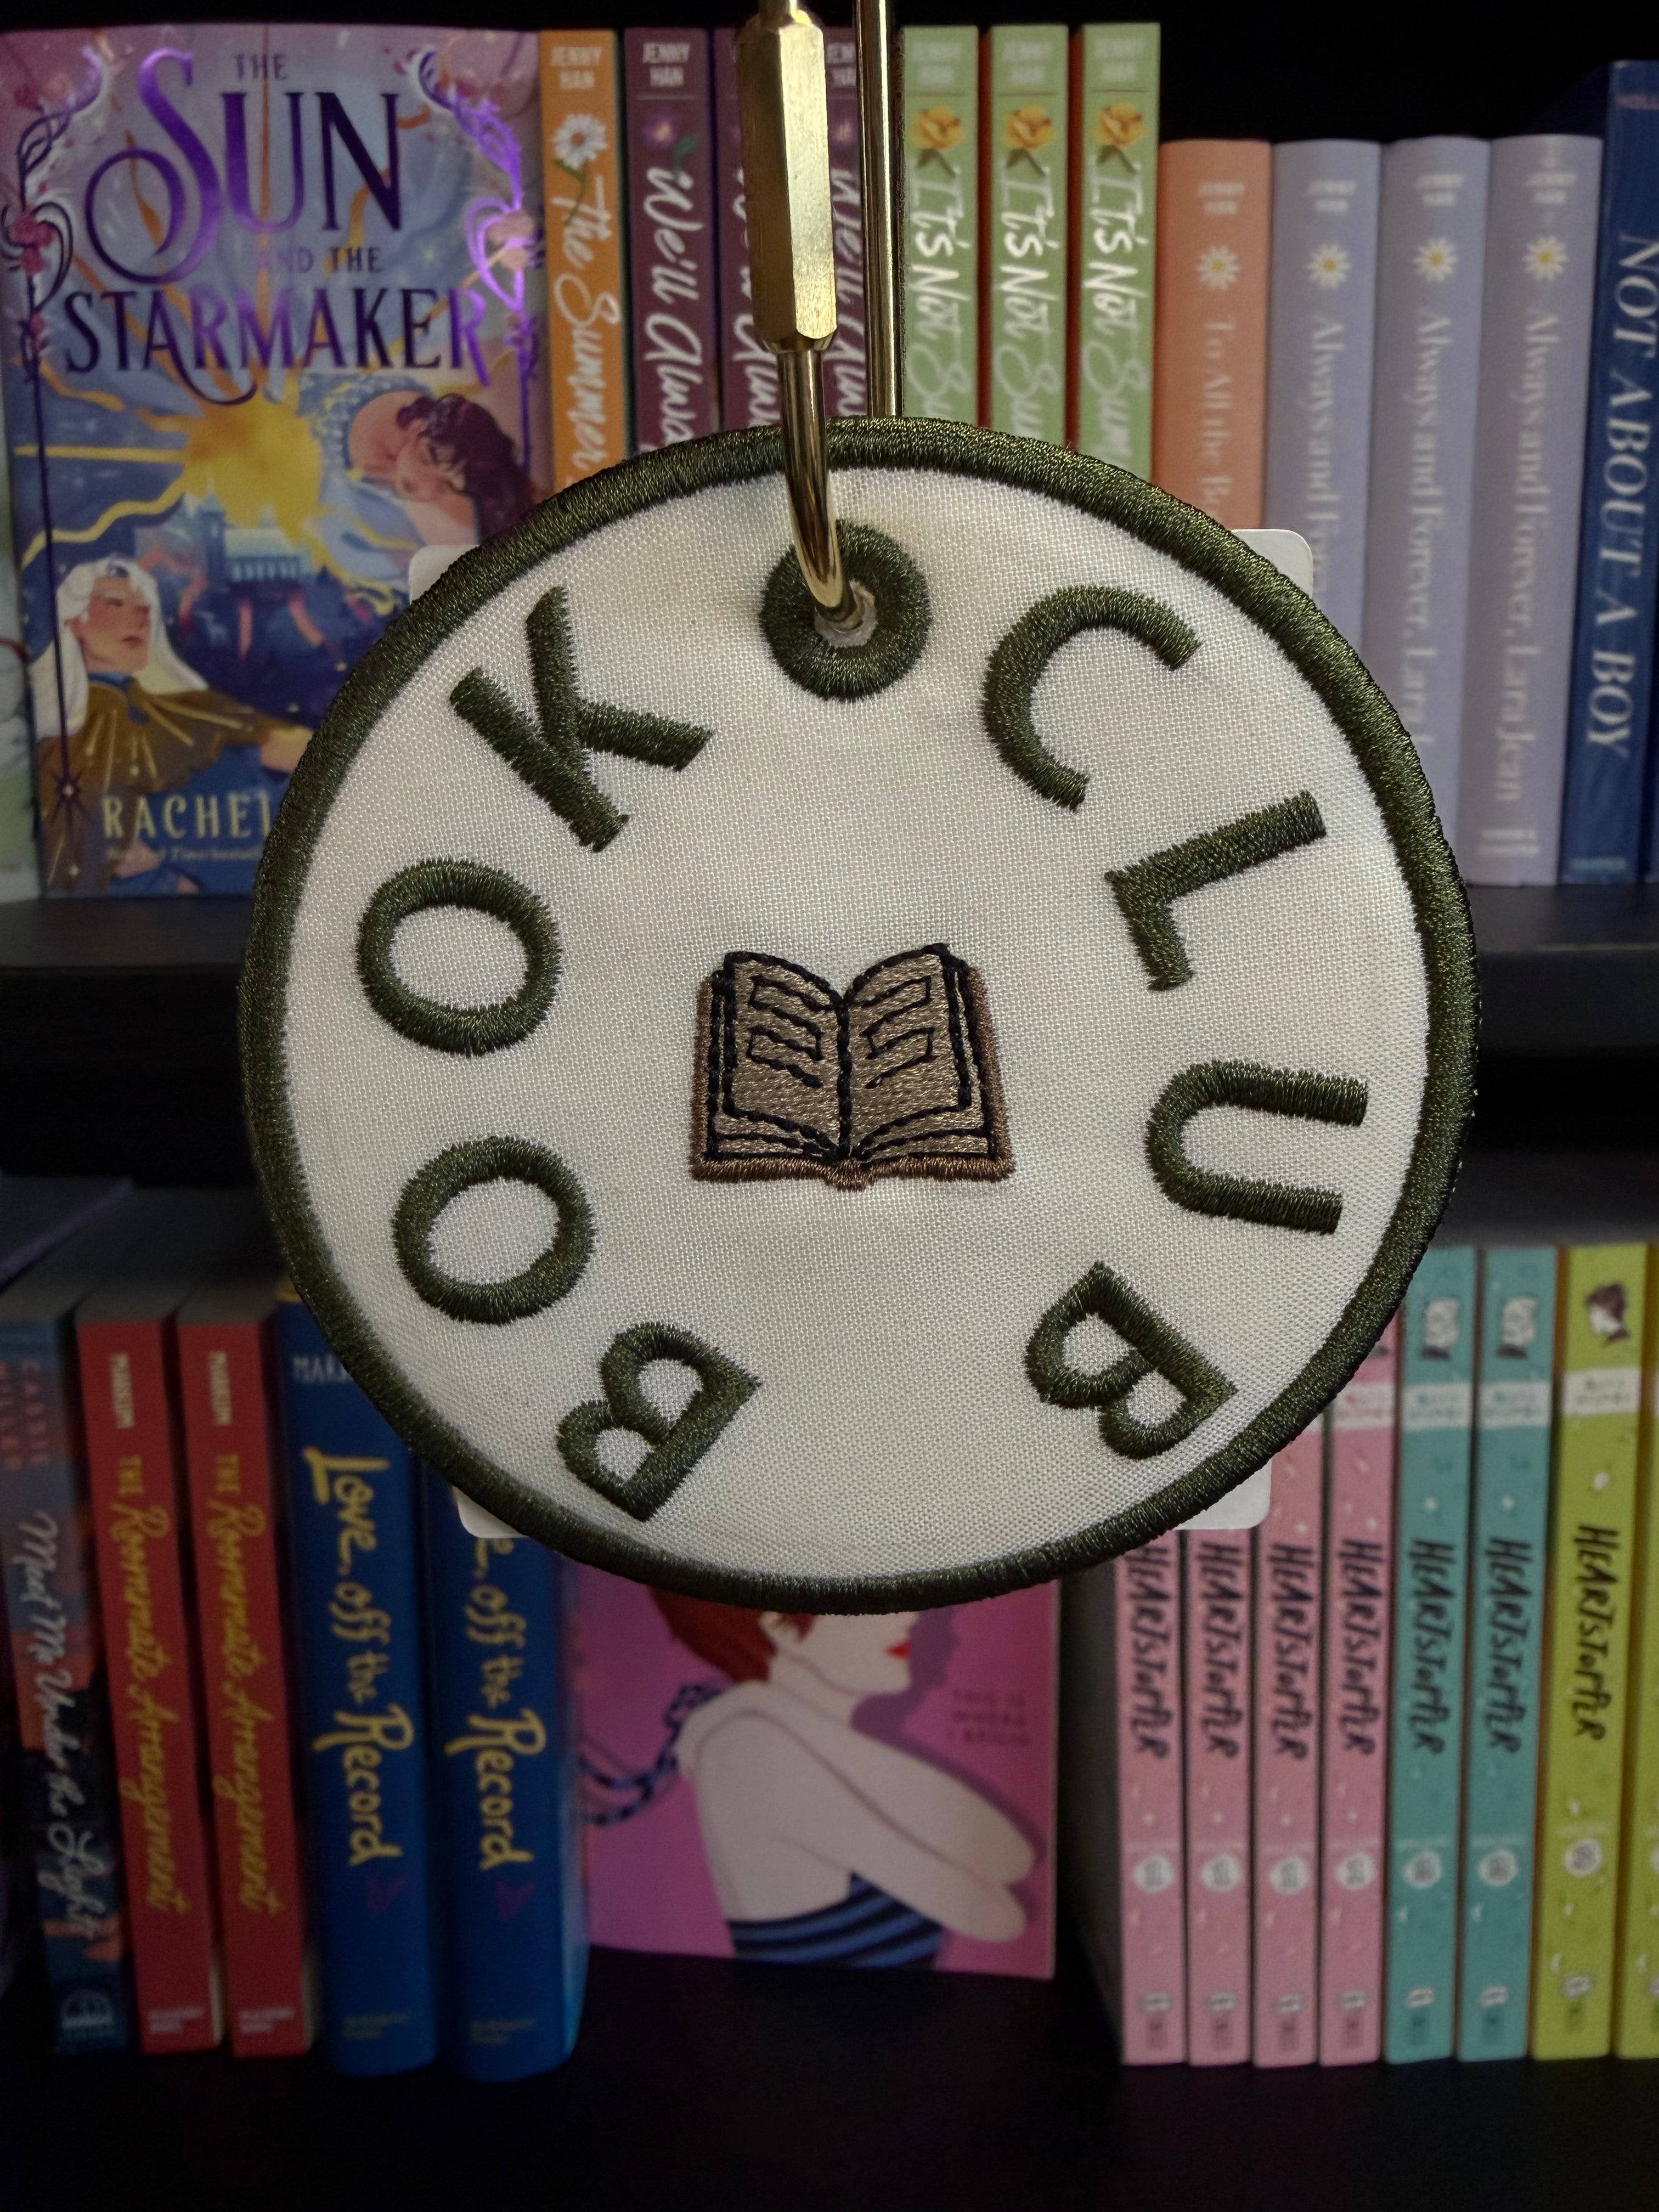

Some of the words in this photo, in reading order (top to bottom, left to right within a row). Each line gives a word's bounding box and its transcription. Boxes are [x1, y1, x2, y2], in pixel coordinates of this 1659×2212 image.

[235, 53, 287, 81] THE
[642, 42, 690, 63] JENNY
[650, 66, 684, 88] HAN
[85, 48, 403, 284] SUN
[910, 156, 972, 257] It's
[1000, 155, 1060, 258] It's
[1090, 154, 1149, 254] It's
[330, 246, 381, 273] THE
[551, 174, 613, 268] The
[642, 167, 703, 304] We'll
[63, 285, 491, 405] STARMAKER
[909, 263, 970, 340] Not
[997, 264, 1058, 340] Not
[1084, 261, 1148, 337] Not
[1206, 318, 1237, 359] To
[1612, 234, 1659, 358] NOT
[554, 273, 622, 471] Summer
[640, 313, 702, 452] Alwa
[1204, 373, 1233, 410] All
[1299, 317, 1345, 431] Always
[1403, 311, 1452, 425] Always
[1510, 311, 1560, 425] Always
[1203, 418, 1232, 462] the
[1306, 438, 1340, 501] and
[1411, 432, 1445, 495] and
[1515, 431, 1550, 495] and
[1599, 371, 1653, 577] ABOUT
[1595, 589, 1638, 626] A
[1502, 646, 1540, 723] Lara
[1586, 650, 1635, 758] BOY
[1497, 733, 1534, 801] Jean
[354, 586, 763, 1523] BOOK
[980, 588, 1369, 1462] CLUB
[117, 1454, 144, 1496] THE
[216, 1454, 241, 1493] THE
[109, 1502, 173, 1680] Roommate
[206, 1499, 268, 1679] Roommate
[329, 1581, 392, 1645] off
[463, 1584, 526, 1648] off
[1573, 1525, 1619, 1741] HEARTSTOPPER
[347, 1650, 390, 1705] the
[481, 1654, 525, 1707] the
[1196, 1541, 1243, 1758] HEARTSTOPPER
[1267, 1543, 1314, 1759] HEARTSTOPPER
[1339, 1539, 1383, 1755] HEARTSTOPPER
[1407, 1540, 1455, 1755] HEARTSTOPPER
[1483, 1537, 1533, 1753] HEARTSTOPPER
[35, 1670, 81, 1769] Under
[118, 1683, 190, 1914] Arrangement
[212, 1682, 283, 1915] Arrangement
[312, 1703, 414, 1866] Record
[445, 1707, 546, 1871] Record
